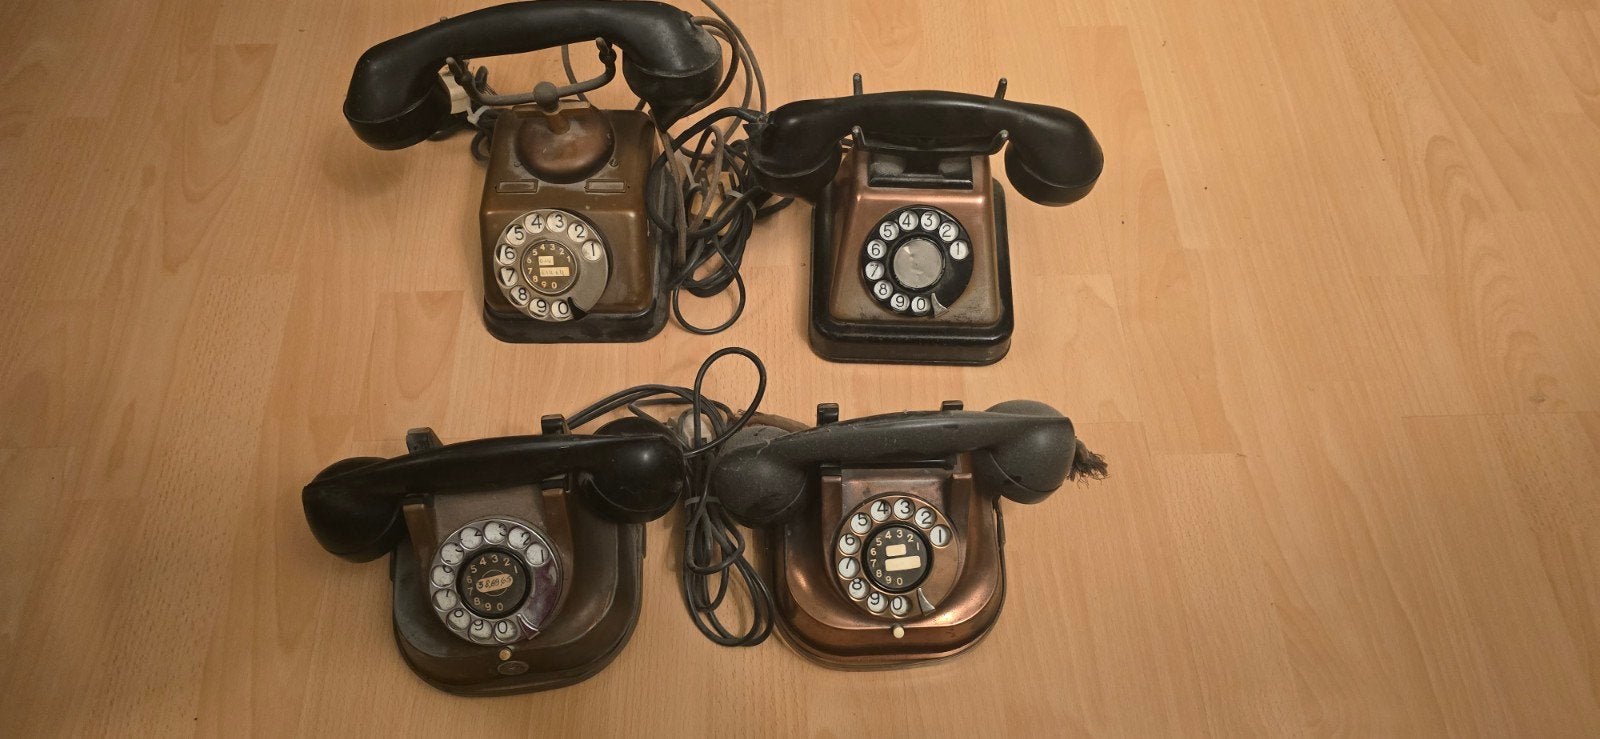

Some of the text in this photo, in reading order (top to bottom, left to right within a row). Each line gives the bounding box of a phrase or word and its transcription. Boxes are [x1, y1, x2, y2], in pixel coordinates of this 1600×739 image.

[531, 215, 542, 229] 4
[555, 214, 564, 228] 3
[902, 214, 911, 227] 4
[924, 213, 933, 227] 3
[514, 227, 524, 240] 5
[574, 224, 585, 238] 2
[883, 224, 892, 238] 5
[942, 224, 951, 238] 2
[504, 246, 515, 260] 6
[871, 243, 880, 256] 6
[506, 268, 515, 282] 7
[870, 264, 879, 277] 7
[518, 288, 527, 300] 8
[878, 283, 888, 296] 8
[536, 300, 547, 313] 9
[895, 295, 905, 308] 9
[916, 298, 926, 310] 0
[558, 301, 568, 315] 0
[877, 502, 888, 514] 4
[900, 502, 911, 514] 3
[857, 513, 868, 527] 5
[921, 510, 932, 524] 2
[521, 531, 530, 546] 2
[885, 531, 892, 539] 4
[896, 529, 903, 538] 3
[906, 534, 914, 542] 2
[845, 535, 855, 545] 6
[876, 537, 882, 546] 5
[479, 557, 487, 566] 4
[492, 554, 498, 563] 3
[503, 557, 510, 566] 2
[870, 559, 877, 568] 7
[471, 565, 477, 573] 5
[876, 570, 882, 578] 8
[466, 576, 473, 584] 6
[852, 579, 862, 590] 8
[885, 576, 892, 584] 9
[896, 578, 903, 586] 0
[467, 587, 474, 596] 7
[474, 597, 481, 606] 8
[870, 593, 880, 605] 9
[892, 596, 903, 611] 0
[485, 602, 492, 611] 9
[497, 602, 504, 611] 0
[474, 619, 484, 631] 9
[497, 620, 508, 634] 0
